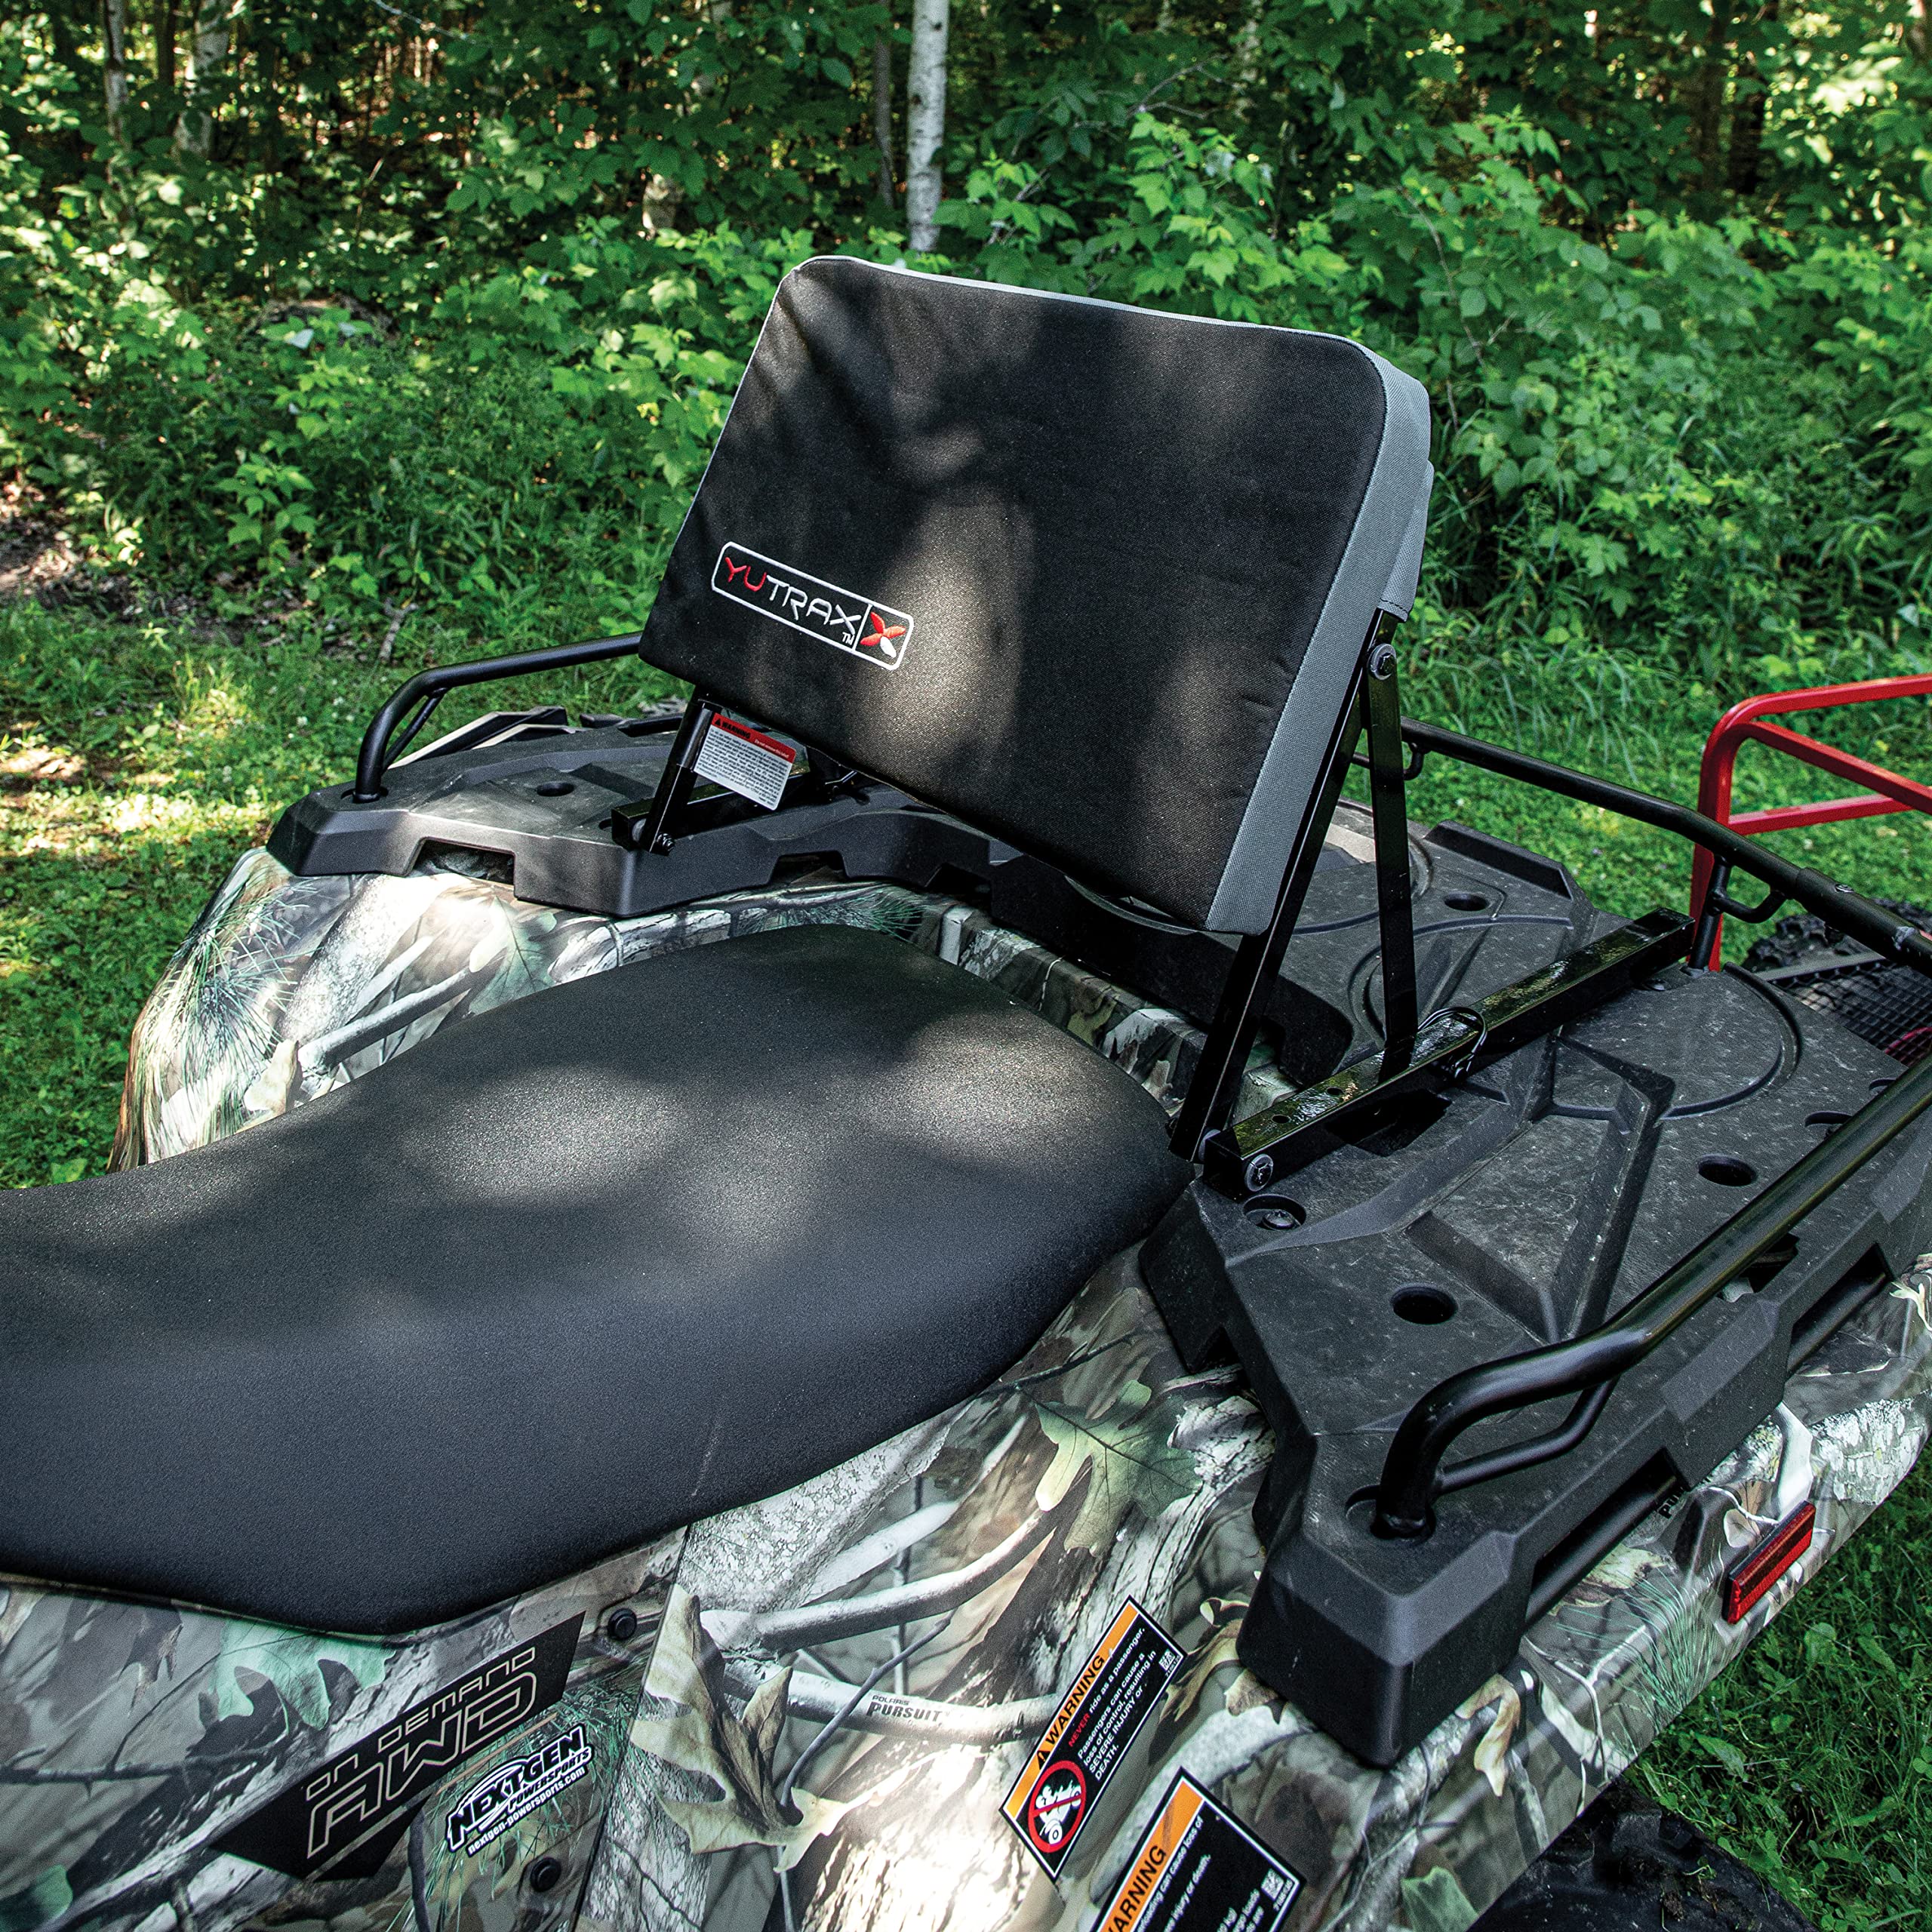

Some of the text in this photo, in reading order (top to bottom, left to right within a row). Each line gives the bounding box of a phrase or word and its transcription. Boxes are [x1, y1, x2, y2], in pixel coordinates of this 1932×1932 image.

[724, 556, 862, 635] YUTRAX
[721, 721, 751, 739] WARNING
[306, 1646, 536, 1801] ON DEMAND
[866, 1701, 943, 1722] PURSUIT
[872, 1694, 910, 1706] POLARIS
[1046, 1654, 1106, 1746] WARNING
[1068, 1627, 1146, 1748] NEVER ride as a passenger.
[1077, 1652, 1146, 1760] Passengers can cause a
[1083, 1745, 1098, 1766] loss
[1096, 1732, 1104, 1746] of
[1124, 1660, 1151, 1700] resulting
[1147, 1650, 1157, 1662] in
[1089, 1684, 1143, 1774] SEVERE INJURY or
[307, 1670, 537, 1860] AWD
[509, 1746, 591, 1811] POWERSPORTS
[1094, 1743, 1120, 1781] DEATH.
[467, 1766, 586, 1856] nextgen-powersports.com
[1109, 1845, 1167, 1932] ARNING
